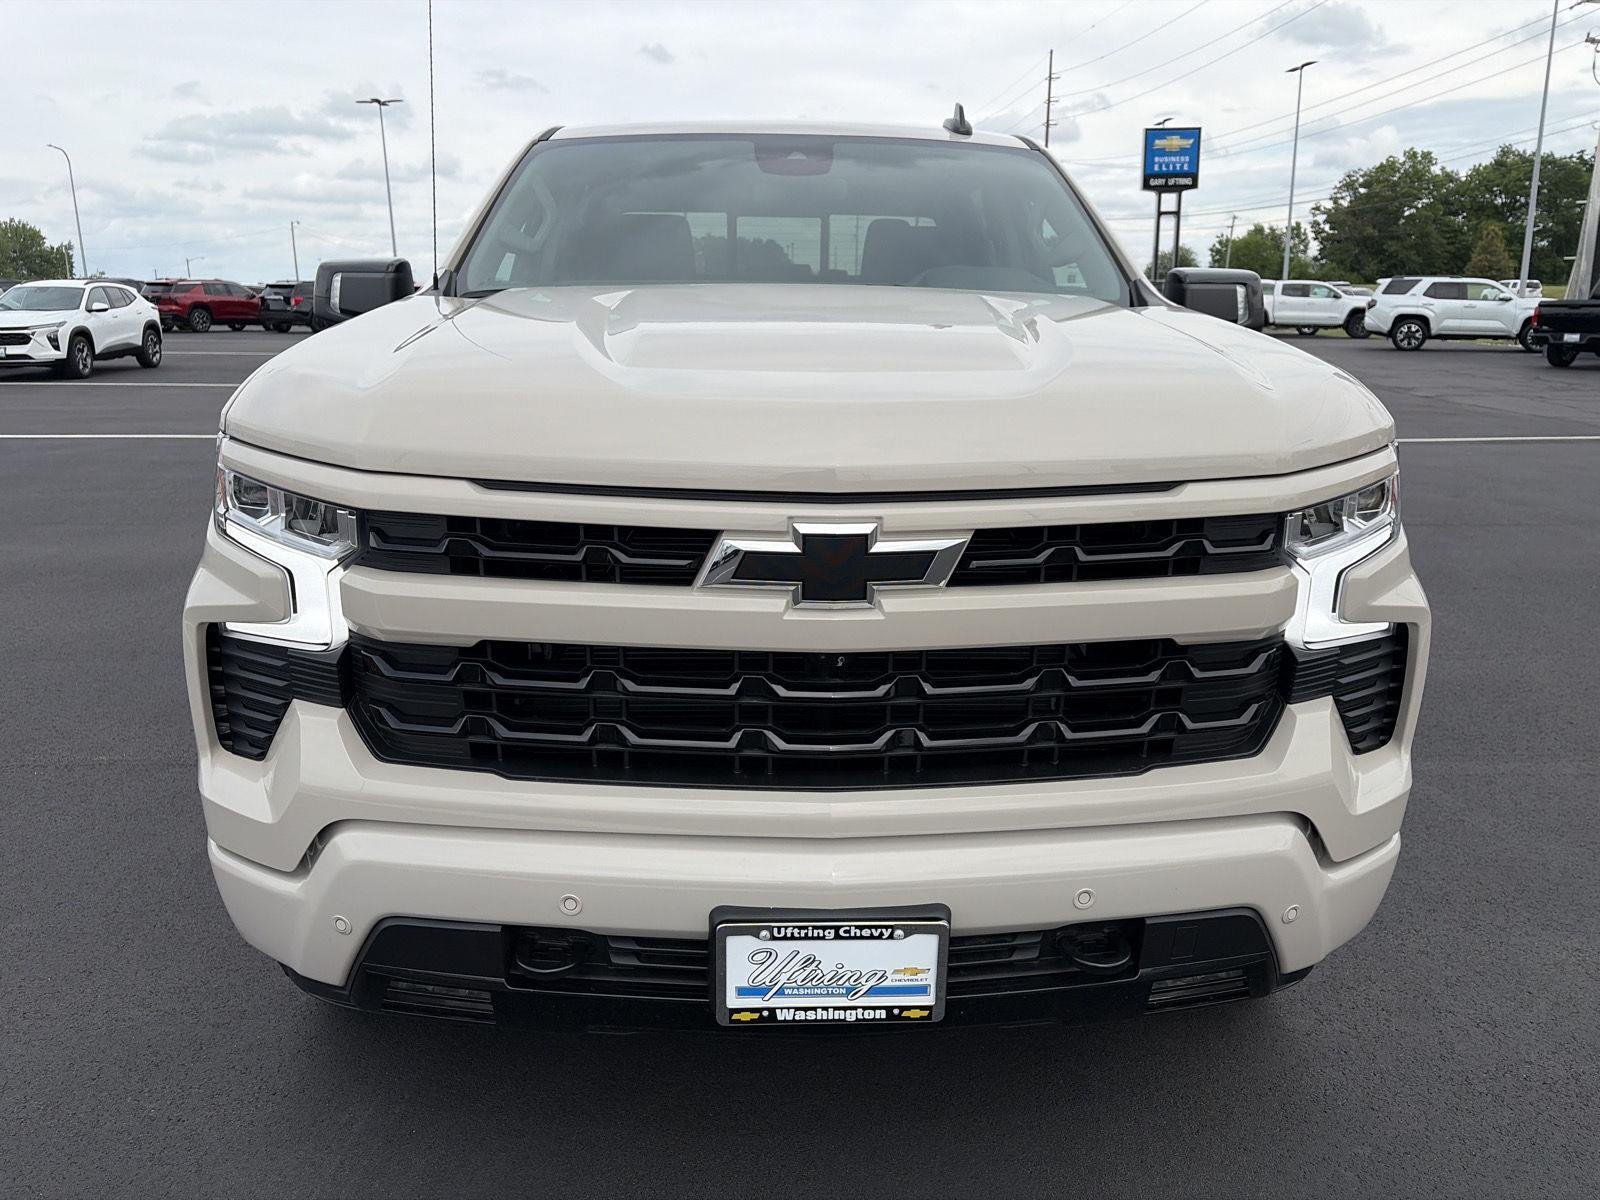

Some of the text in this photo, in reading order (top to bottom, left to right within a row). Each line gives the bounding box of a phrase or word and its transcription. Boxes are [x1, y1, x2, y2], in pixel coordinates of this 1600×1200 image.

[1154, 163, 1188, 171] ELITE
[1149, 178, 1166, 186] GARY
[773, 926, 892, 939] Uftring Chevy
[747, 947, 889, 1001] Uftring
[784, 987, 847, 995] WASHINGTON
[775, 1008, 887, 1021] Washington
